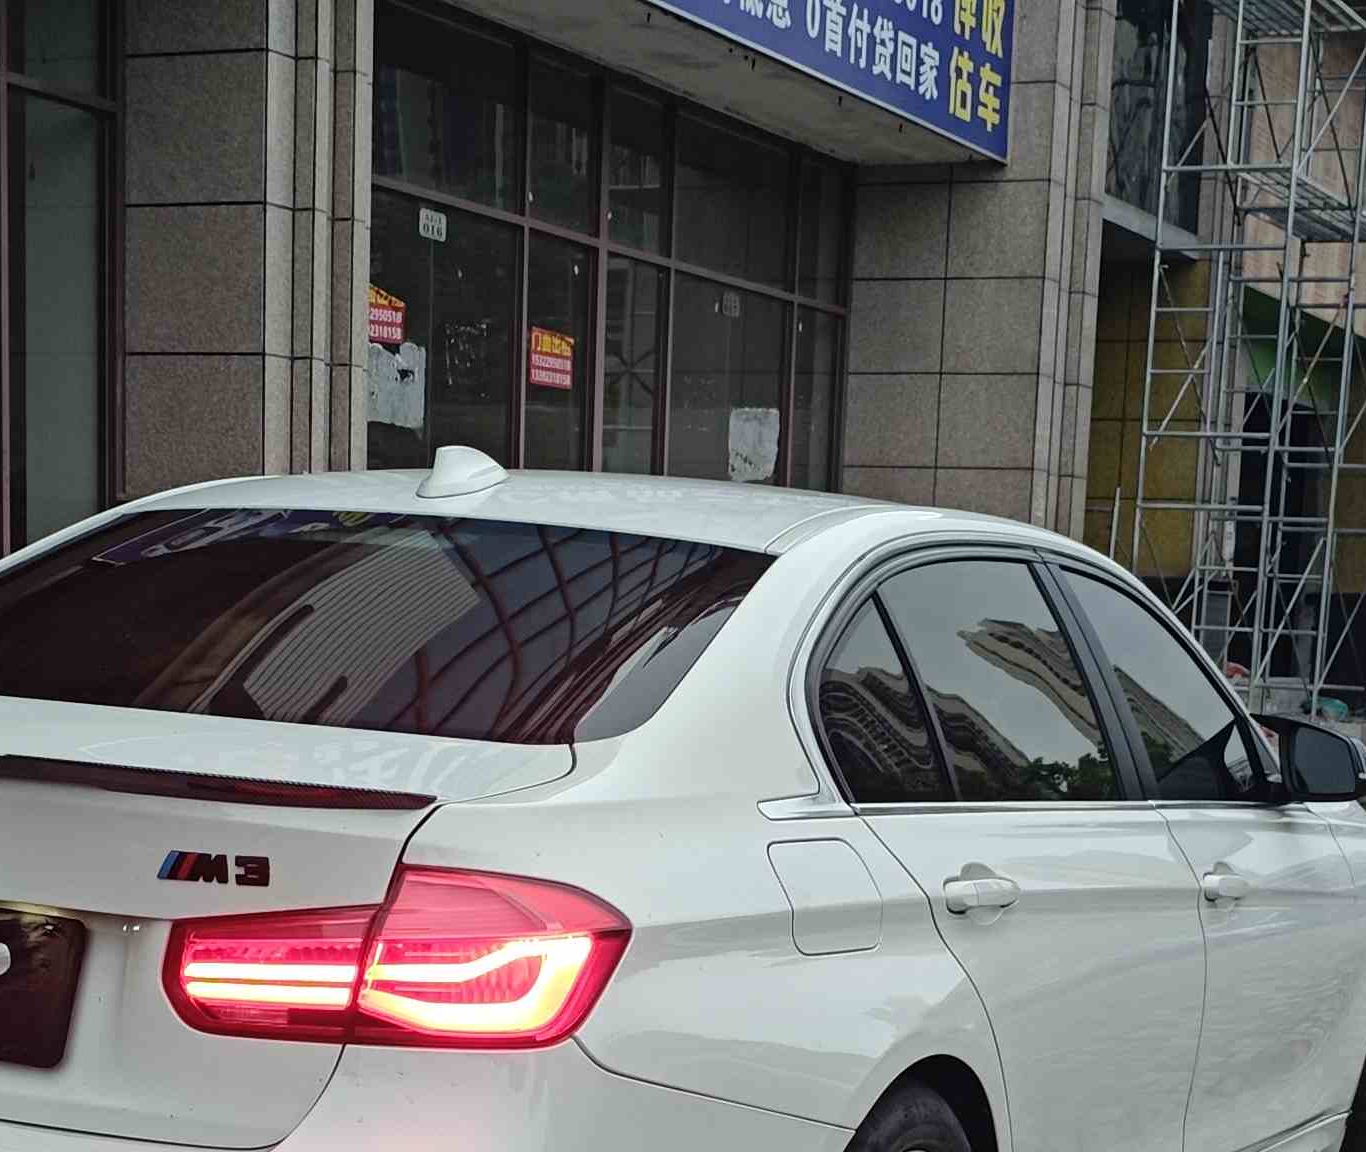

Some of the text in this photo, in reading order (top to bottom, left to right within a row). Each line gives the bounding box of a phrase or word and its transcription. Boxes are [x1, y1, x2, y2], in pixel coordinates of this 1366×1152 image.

[806, 0, 940, 101] 0首付贷回家
[169, 850, 270, 887] M3
